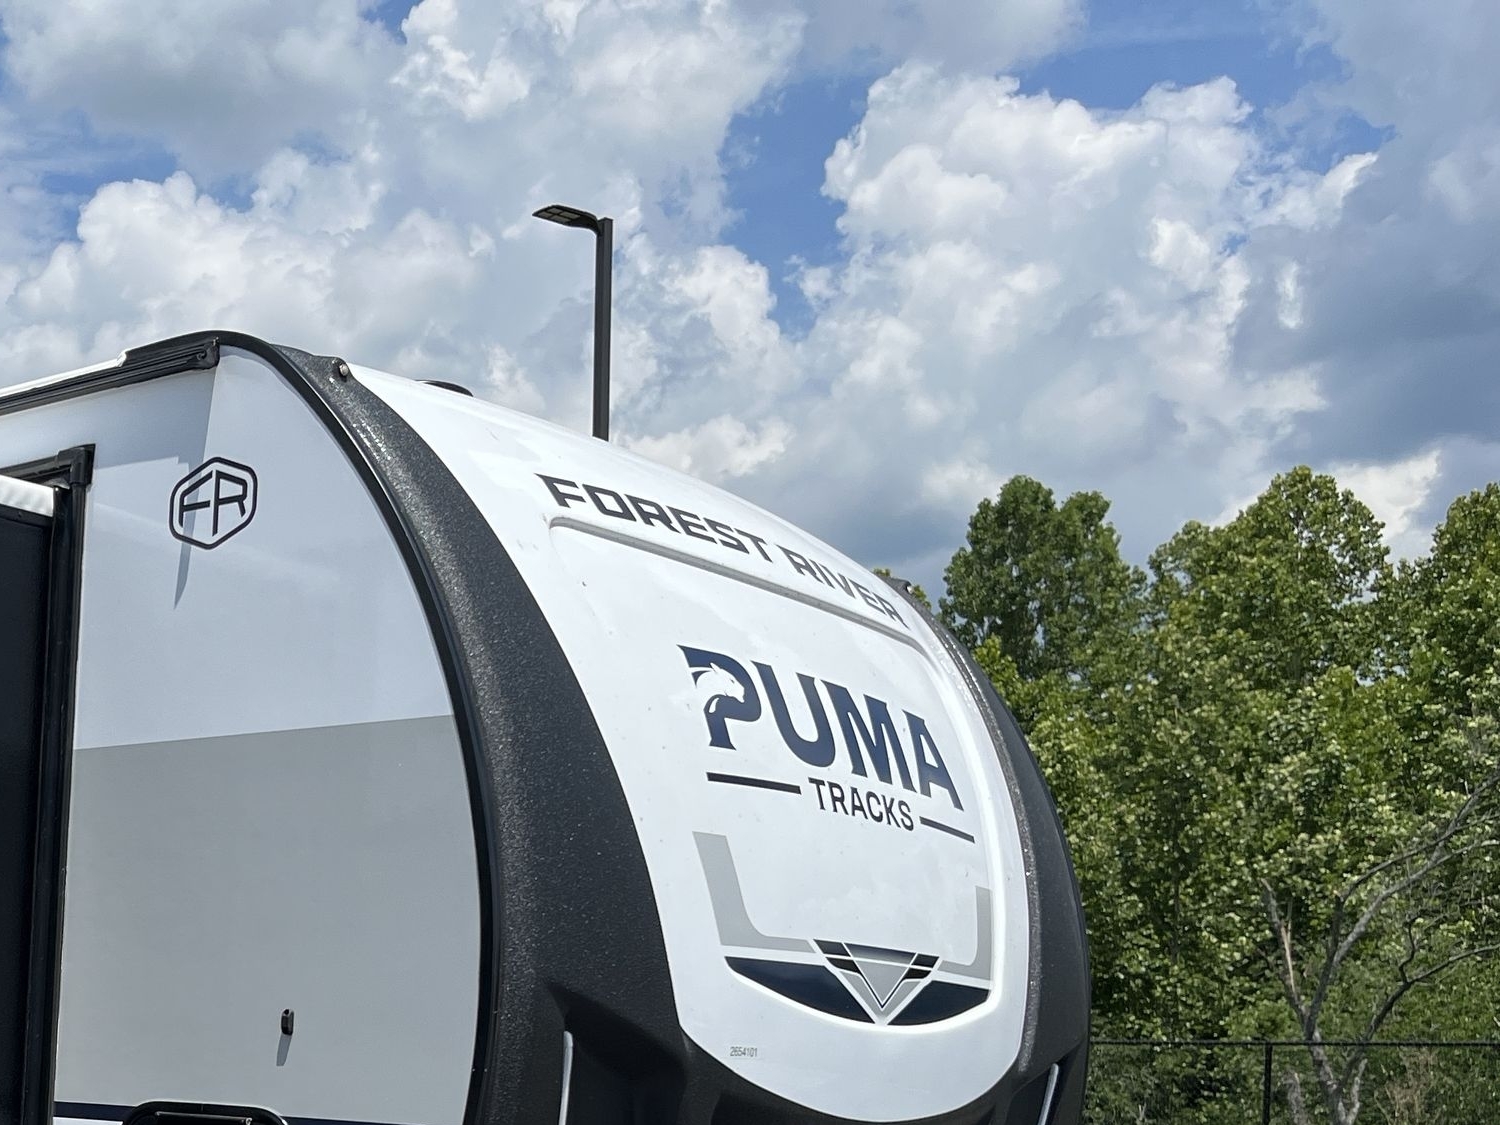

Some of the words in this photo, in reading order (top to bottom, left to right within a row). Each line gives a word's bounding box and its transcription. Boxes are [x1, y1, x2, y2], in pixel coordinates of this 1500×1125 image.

[534, 473, 773, 564] FOREST
[774, 544, 911, 630] RIVER
[676, 644, 964, 812] PUMA
[808, 777, 914, 831] TRACKS
